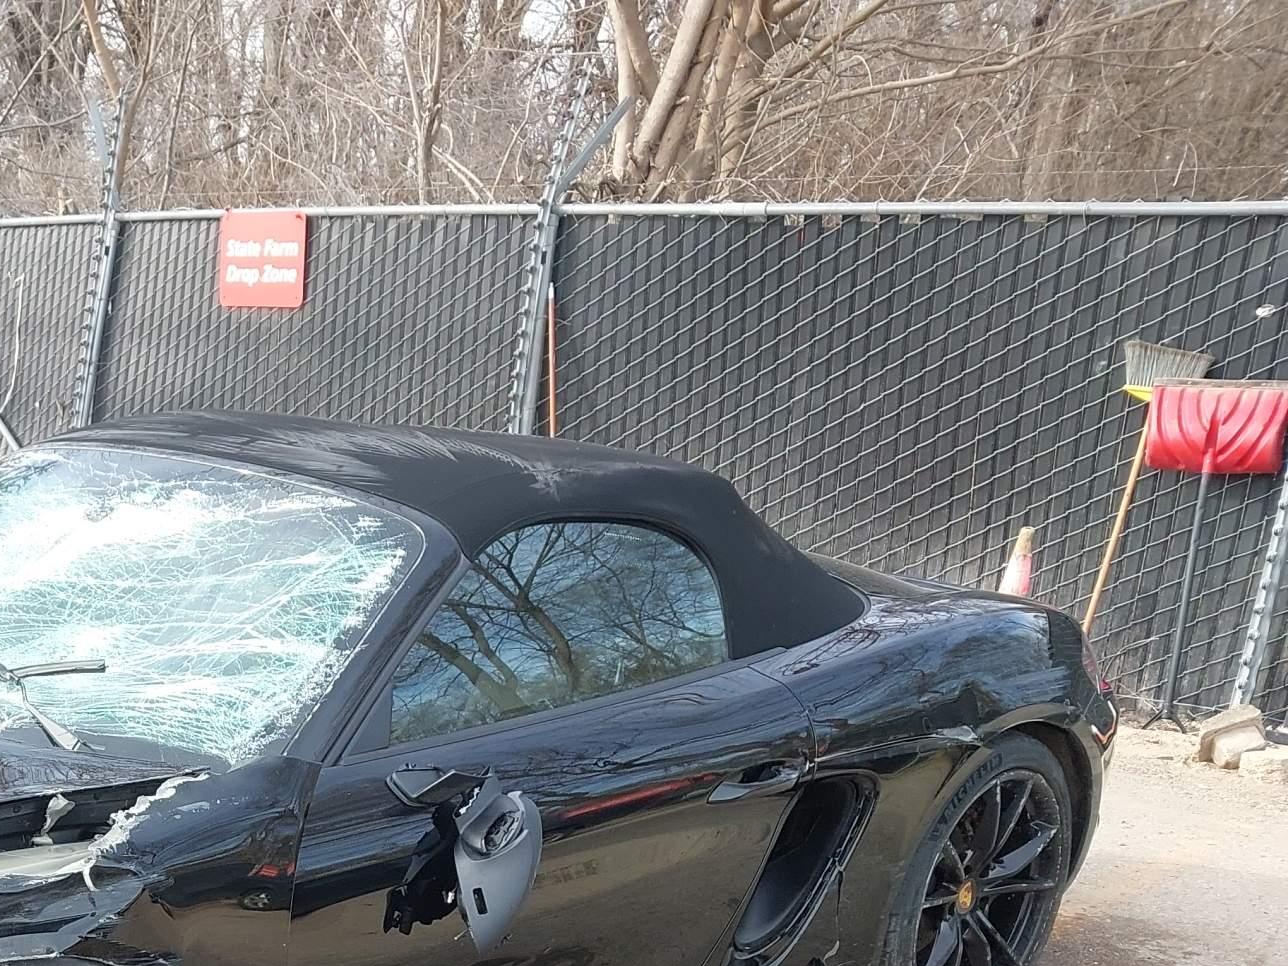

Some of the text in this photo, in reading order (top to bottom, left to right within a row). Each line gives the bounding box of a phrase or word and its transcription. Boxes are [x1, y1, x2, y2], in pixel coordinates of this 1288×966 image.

[226, 238, 299, 257] State Farm
[226, 264, 297, 288] Drop Zone
